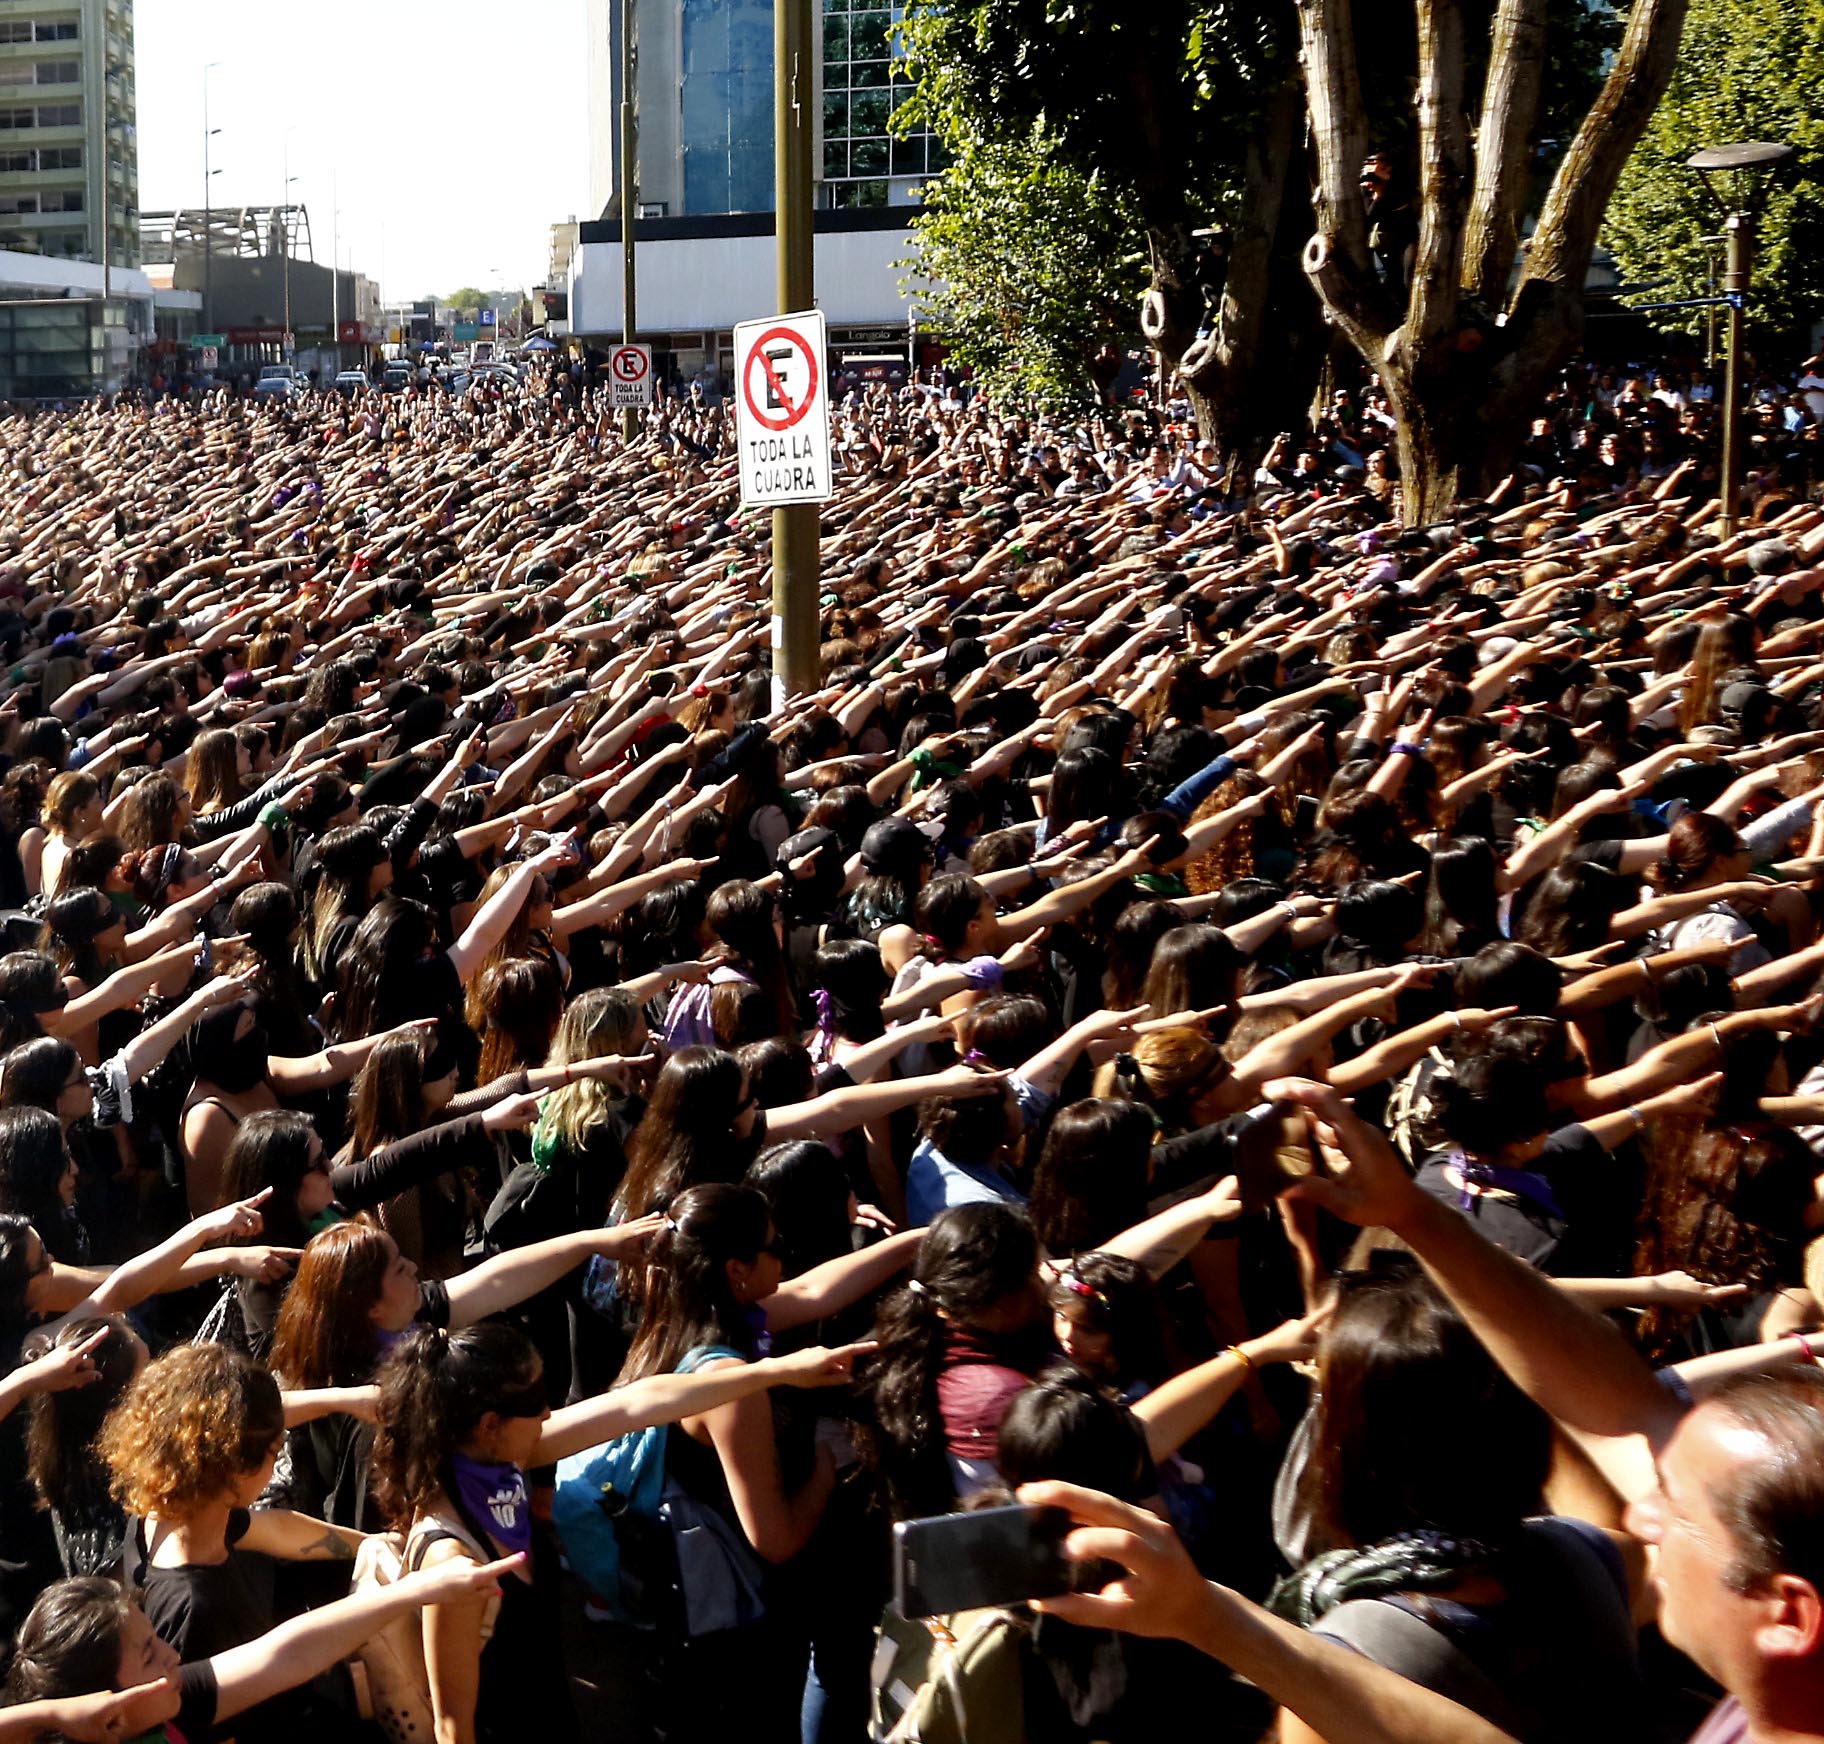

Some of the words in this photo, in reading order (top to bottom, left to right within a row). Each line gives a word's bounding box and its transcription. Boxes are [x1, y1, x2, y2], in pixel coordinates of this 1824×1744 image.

[483, 311, 491, 323] E
[615, 384, 632, 393] TODA
[634, 384, 643, 392] LA
[616, 394, 644, 403] CUADRA
[750, 437, 787, 464] TODA
[792, 434, 814, 460] LA
[755, 466, 817, 494] CUADRA
